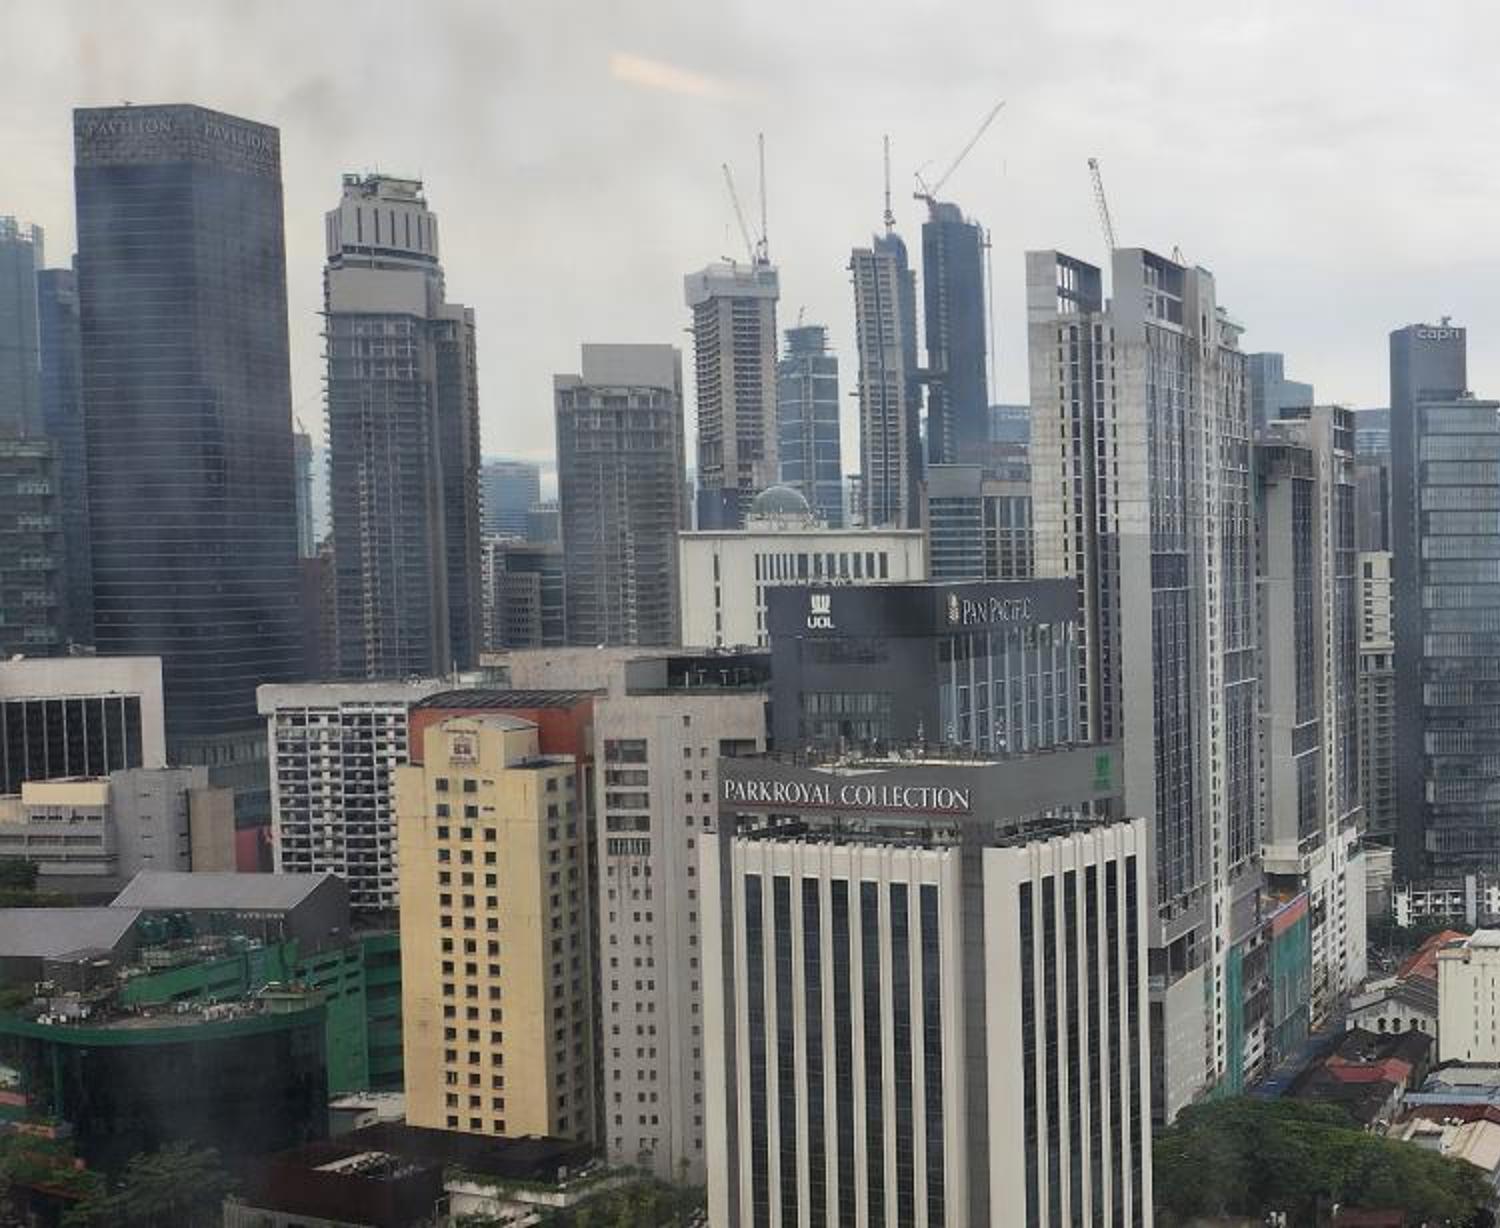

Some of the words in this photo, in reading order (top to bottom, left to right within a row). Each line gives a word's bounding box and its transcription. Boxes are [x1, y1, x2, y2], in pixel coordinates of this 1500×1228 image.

[807, 616, 835, 628] UOL
[963, 599, 987, 624] PAN
[725, 779, 834, 804] PARKROYAL
[841, 785, 970, 809] COLLECTION
